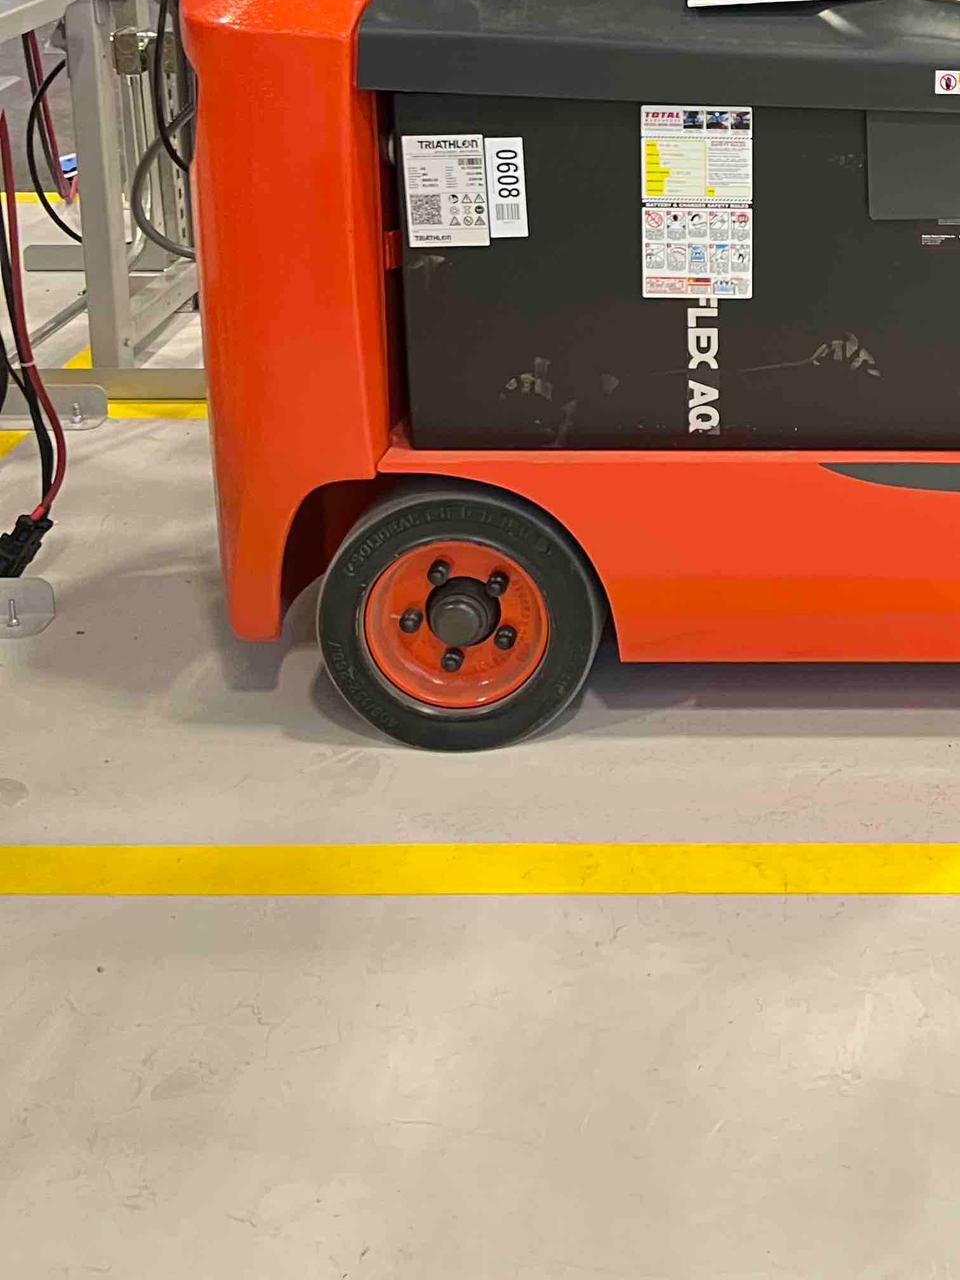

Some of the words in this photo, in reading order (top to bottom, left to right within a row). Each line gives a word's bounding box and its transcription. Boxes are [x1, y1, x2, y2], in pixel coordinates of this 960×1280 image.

[644, 111, 681, 119] TOTAL
[417, 139, 479, 150] TRIATHLON
[496, 149, 520, 198] 0608
